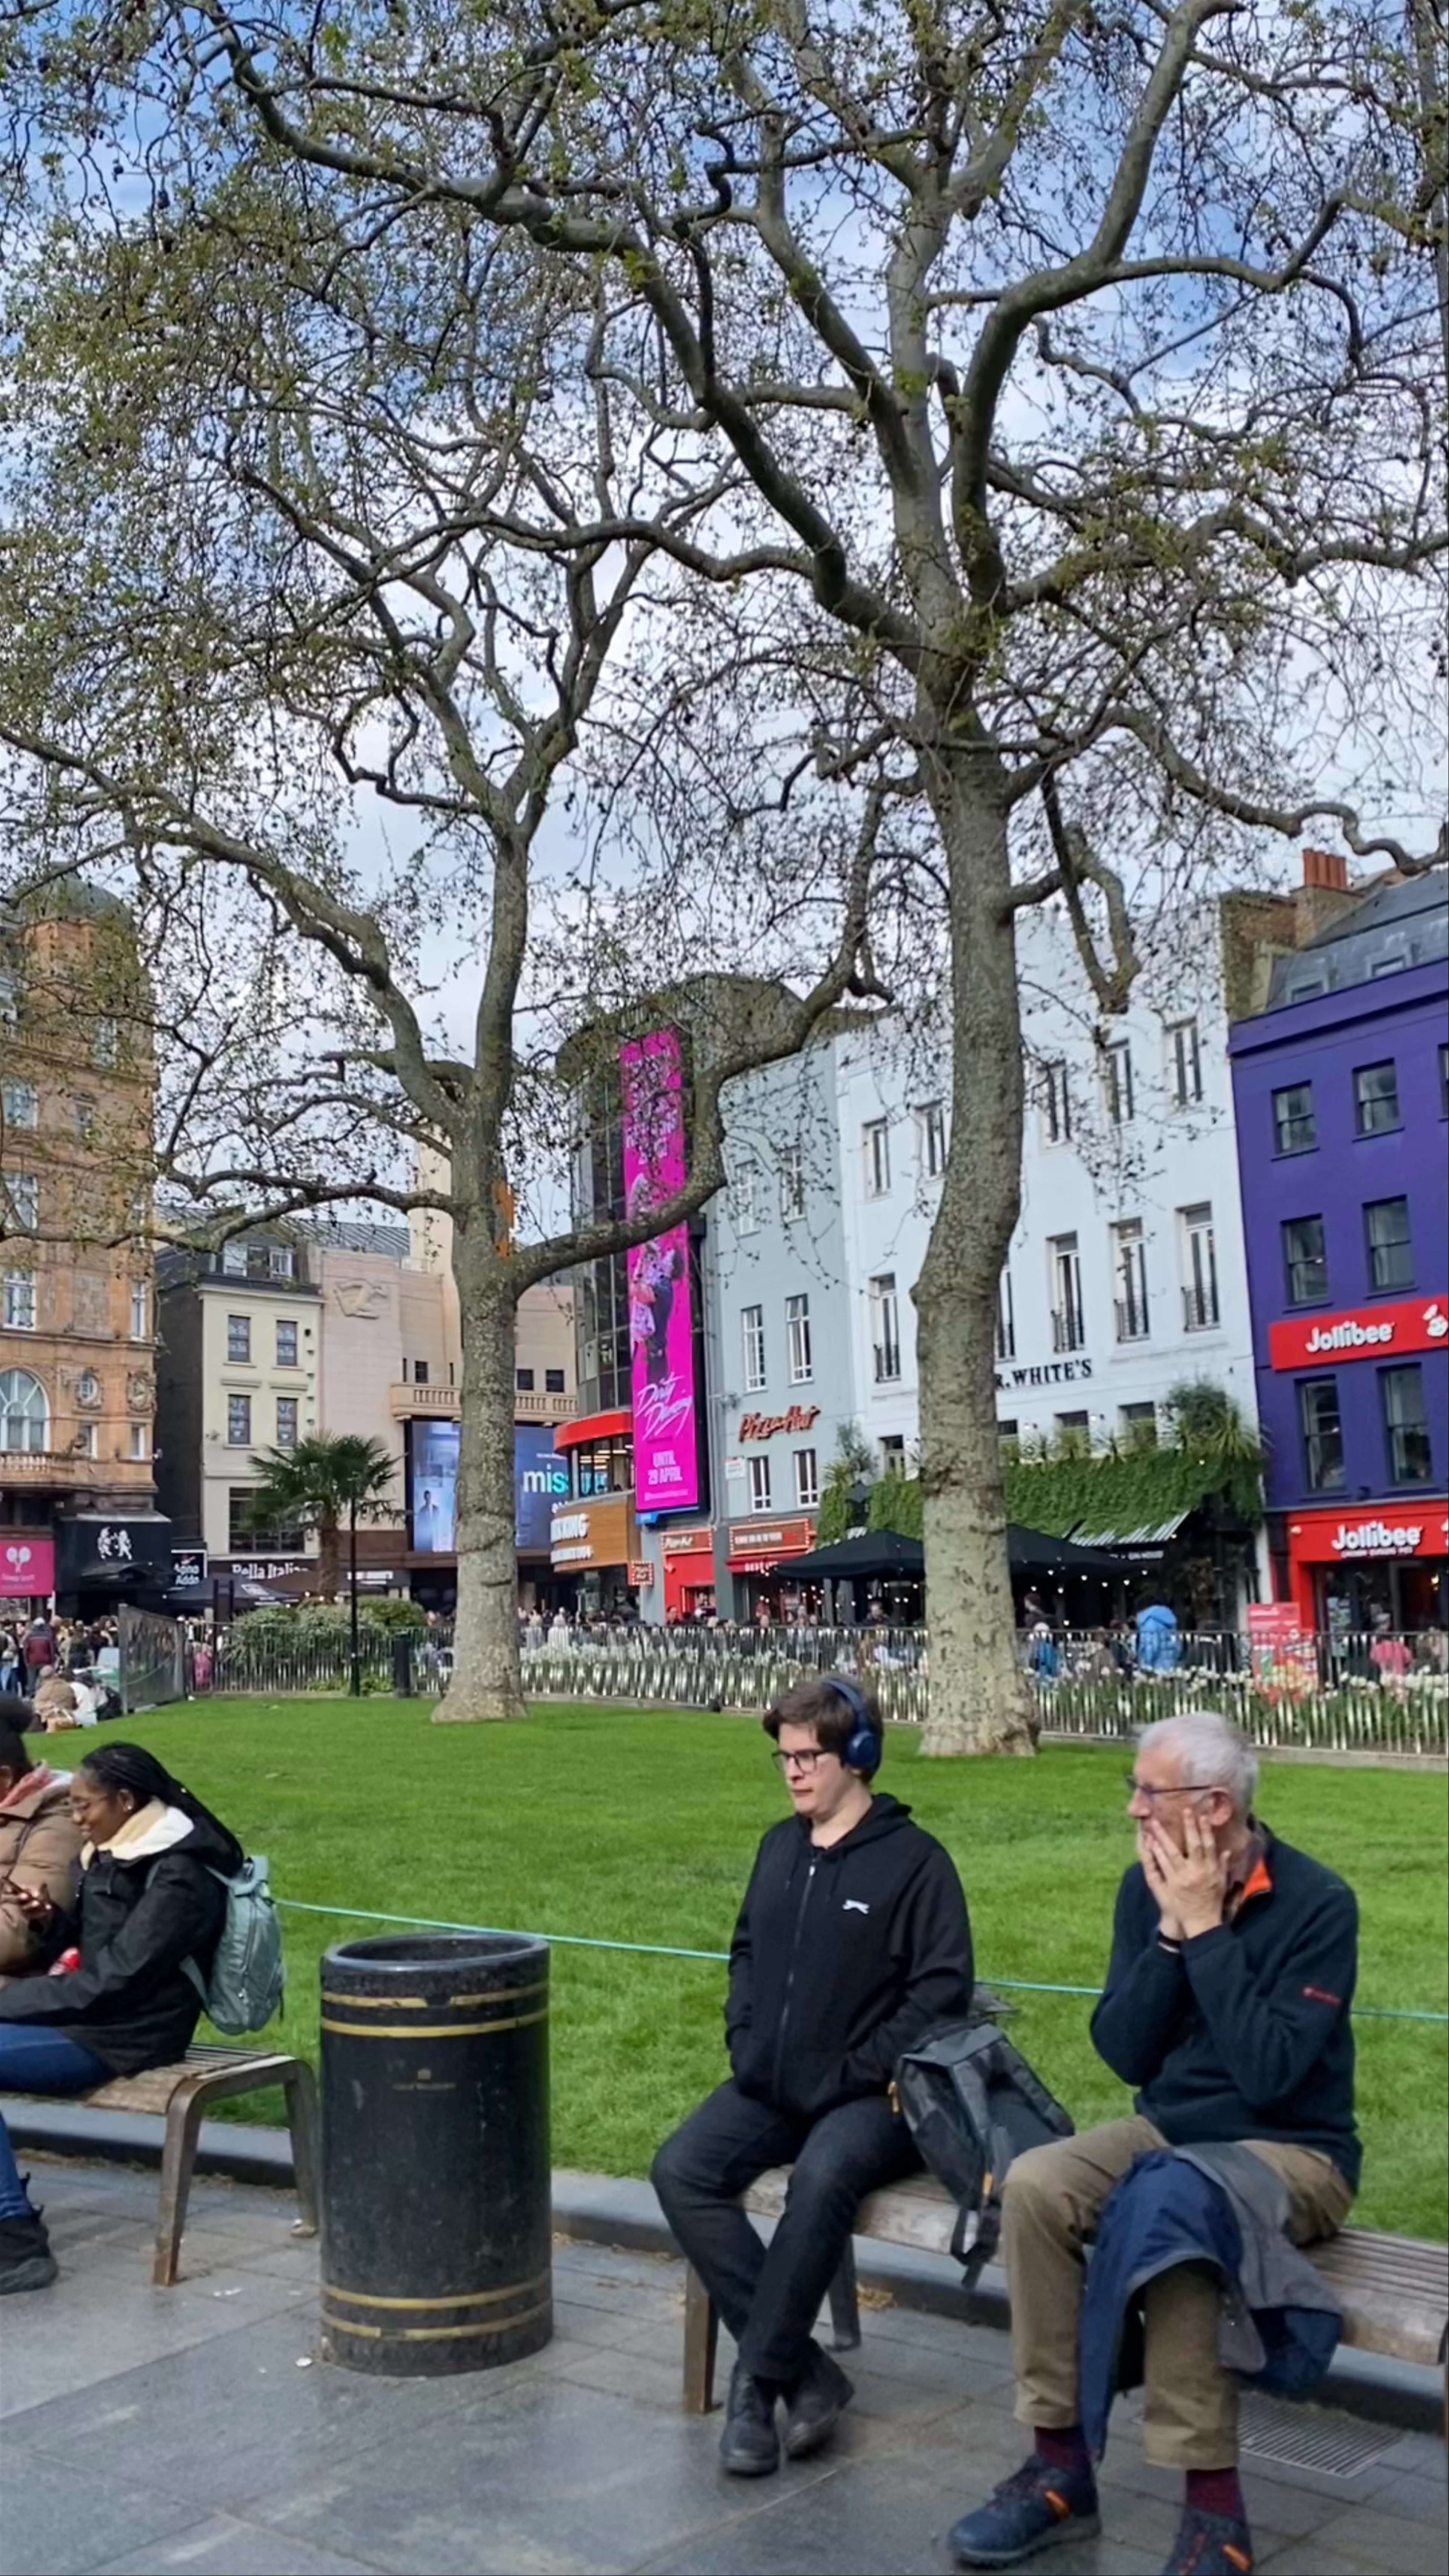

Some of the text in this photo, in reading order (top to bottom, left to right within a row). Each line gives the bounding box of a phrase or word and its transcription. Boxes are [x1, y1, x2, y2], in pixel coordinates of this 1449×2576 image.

[1305, 1321, 1393, 1352] Jollibee
[1012, 1358, 1092, 1385] WHITE'S
[739, 1406, 821, 1443] Pizza Hut
[1331, 1521, 1421, 1550] Jollibee
